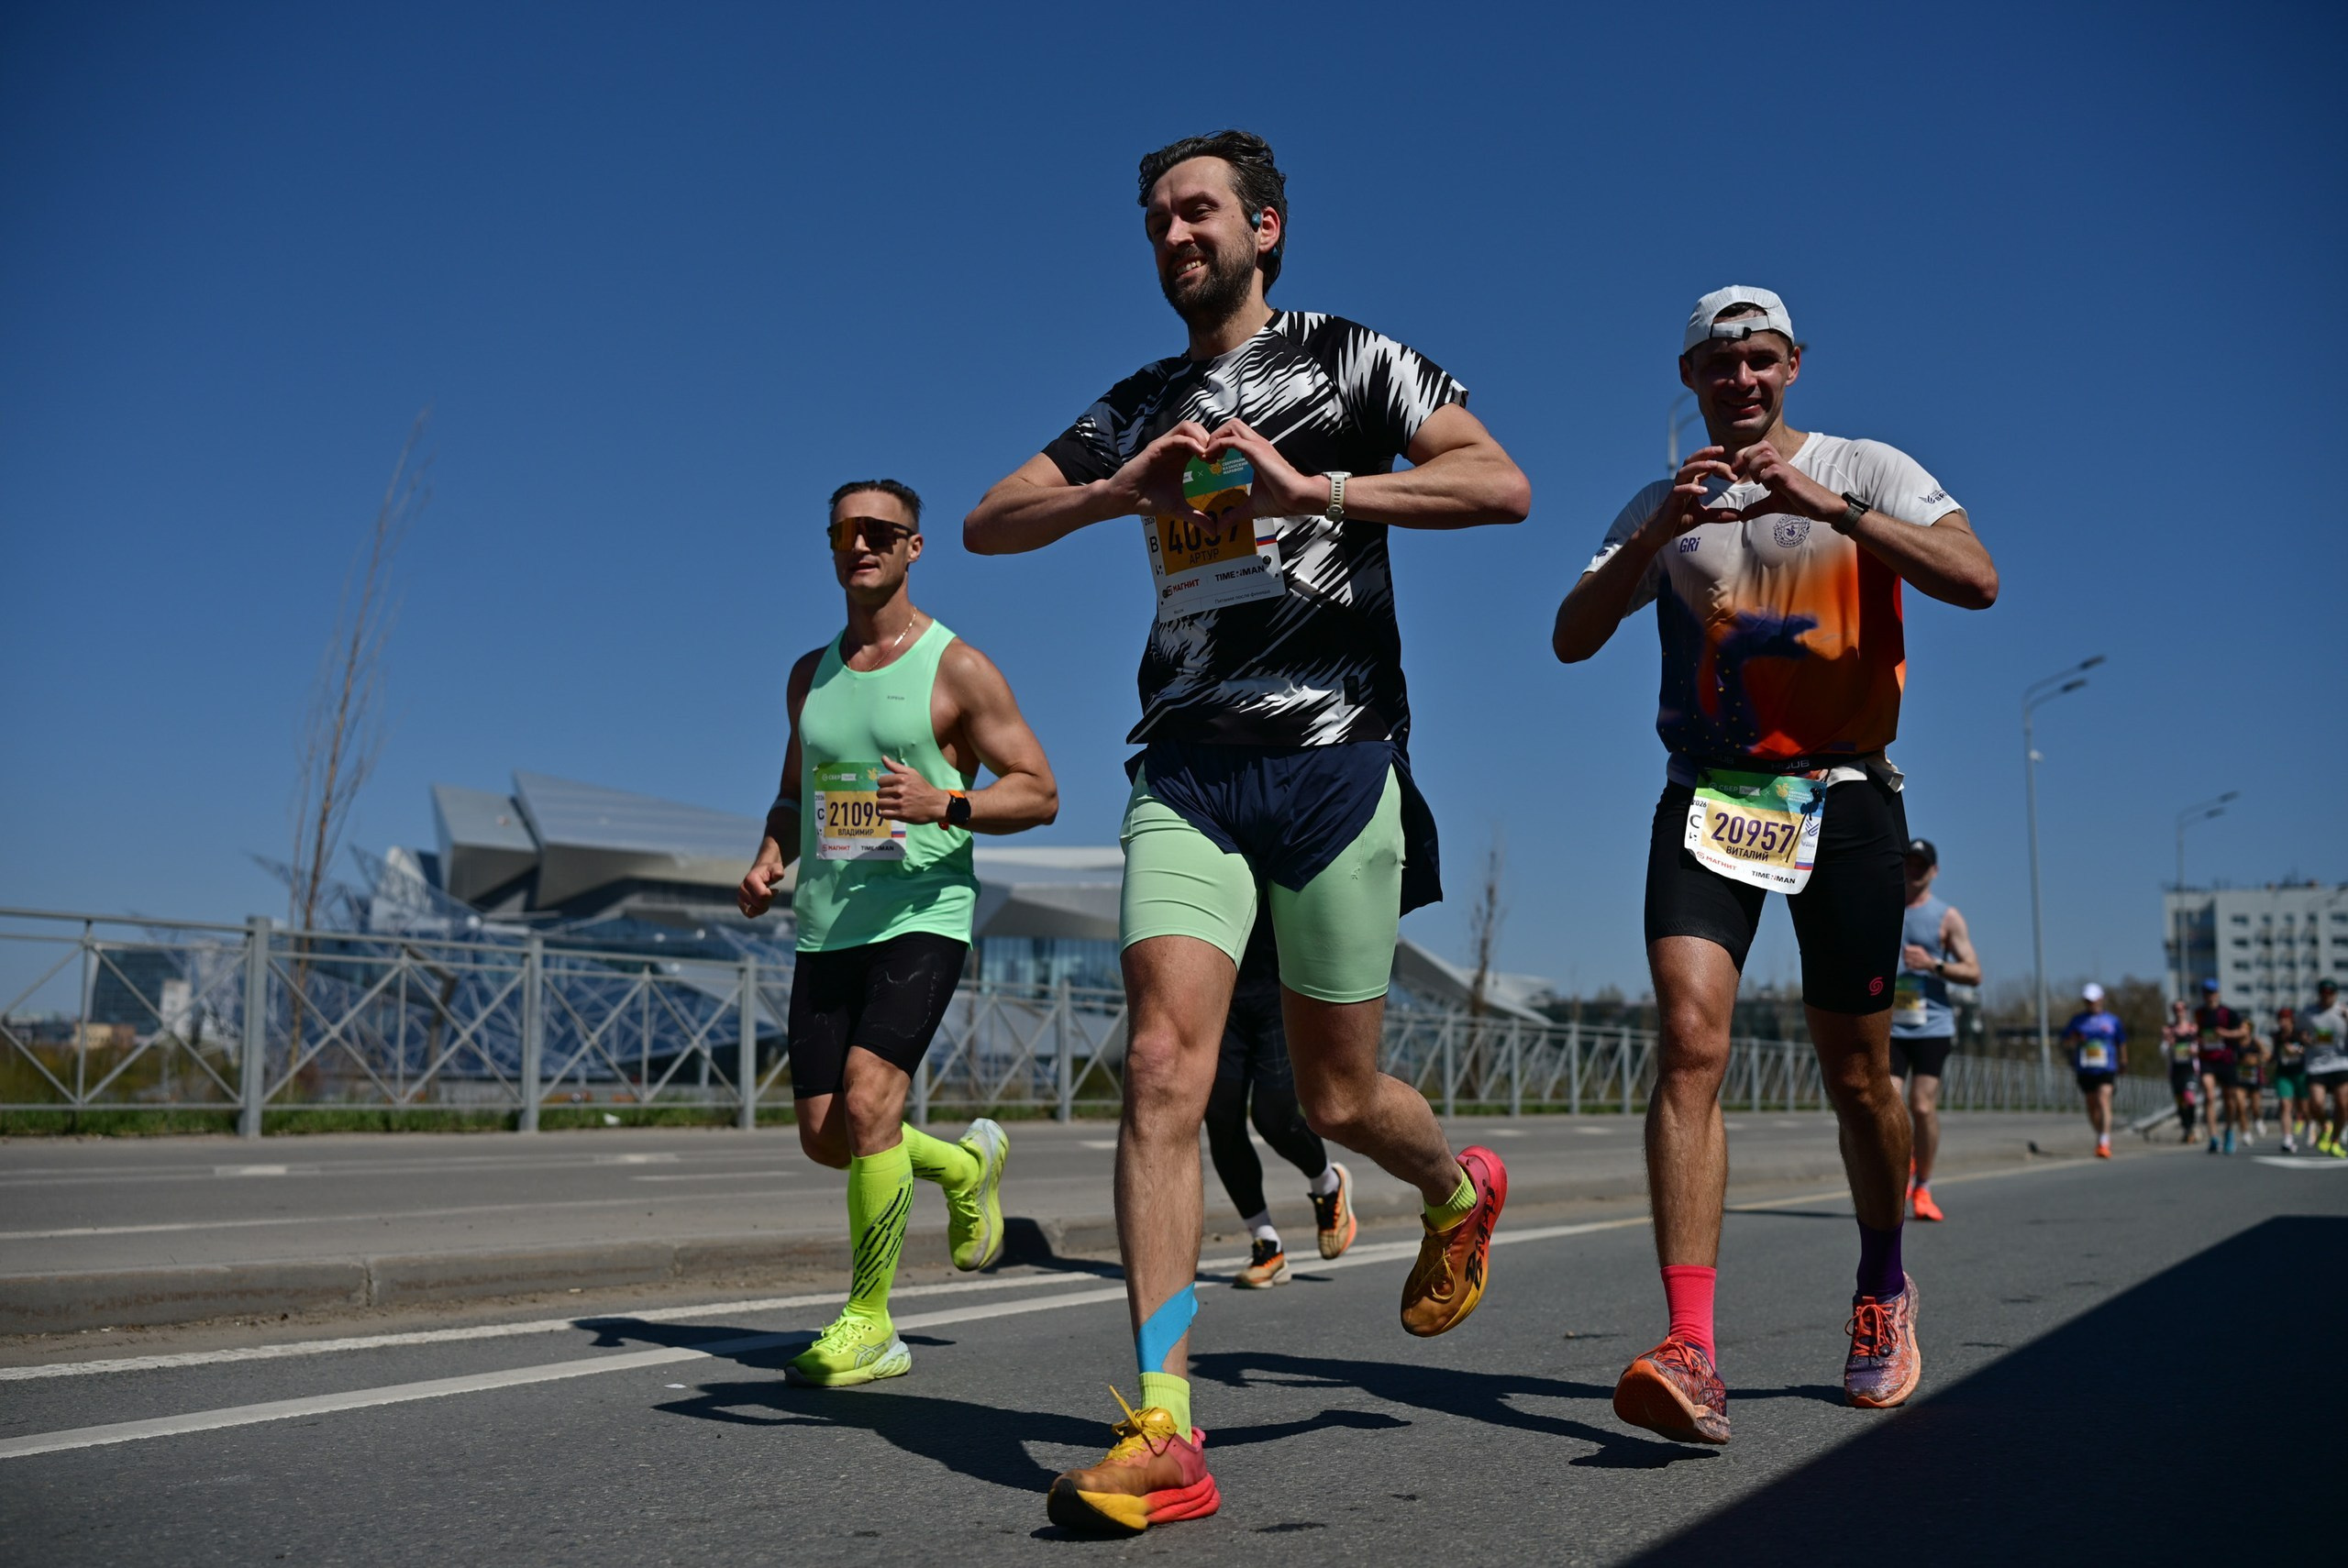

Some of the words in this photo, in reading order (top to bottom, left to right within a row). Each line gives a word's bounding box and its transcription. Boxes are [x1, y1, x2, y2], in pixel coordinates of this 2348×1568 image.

[1190, 549, 1219, 565] АРТУР
[1173, 579, 1200, 592] МАГНИТ
[1711, 812, 1796, 854] 20957
[1726, 846, 1769, 862] ВИТАЛИЙ
[1706, 856, 1737, 870] МАГНИТ
